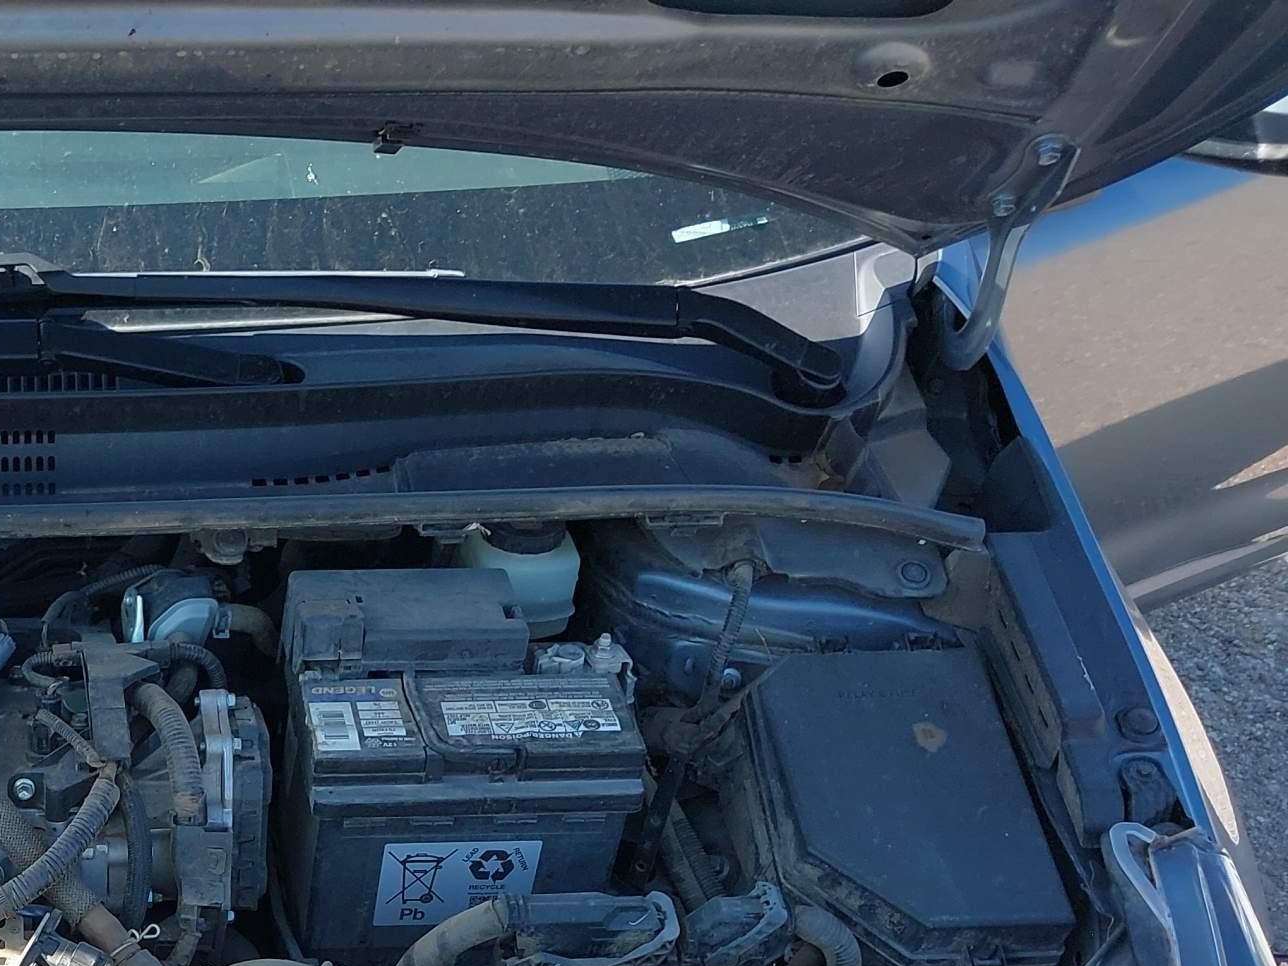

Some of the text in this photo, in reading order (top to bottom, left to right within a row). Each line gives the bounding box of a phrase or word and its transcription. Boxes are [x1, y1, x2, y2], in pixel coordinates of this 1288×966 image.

[311, 686, 376, 695] LEGEND
[461, 847, 481, 864] LEAD
[512, 847, 530, 872] RETURN
[399, 908, 426, 922] Pb
